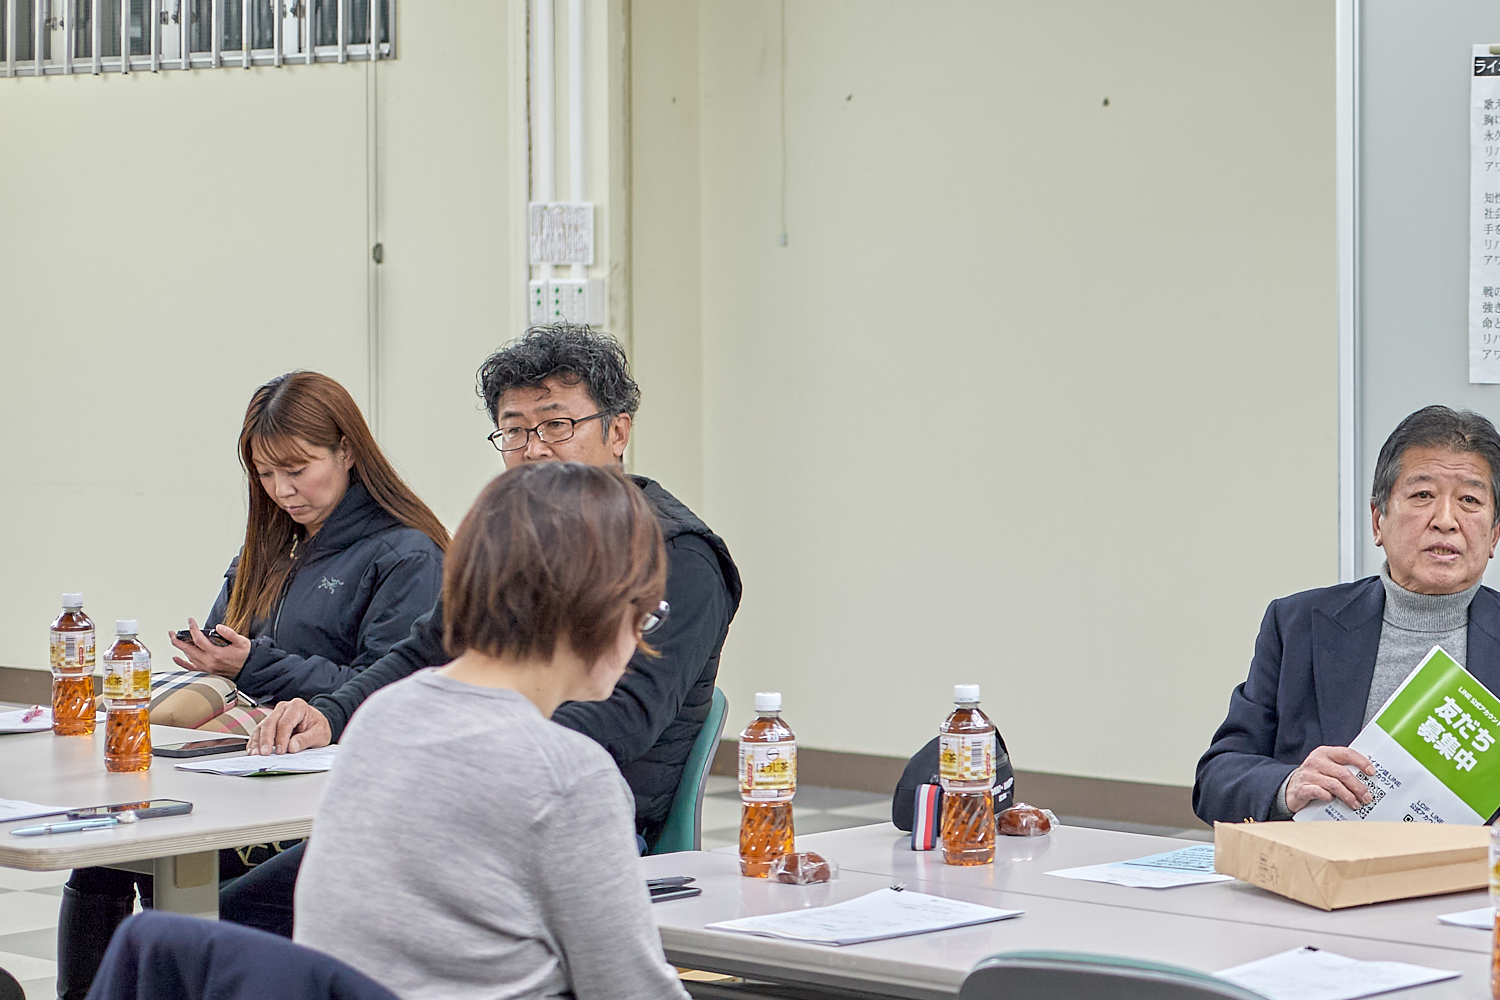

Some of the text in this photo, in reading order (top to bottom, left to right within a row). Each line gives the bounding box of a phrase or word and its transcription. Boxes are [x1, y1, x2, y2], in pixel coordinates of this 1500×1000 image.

[1458, 687, 1472, 701] LINE
[1434, 695, 1496, 752] 友だち
[1417, 715, 1478, 772] 募集中
[756, 761, 788, 773] ほうじ茶
[1388, 774, 1402, 788] LINE
